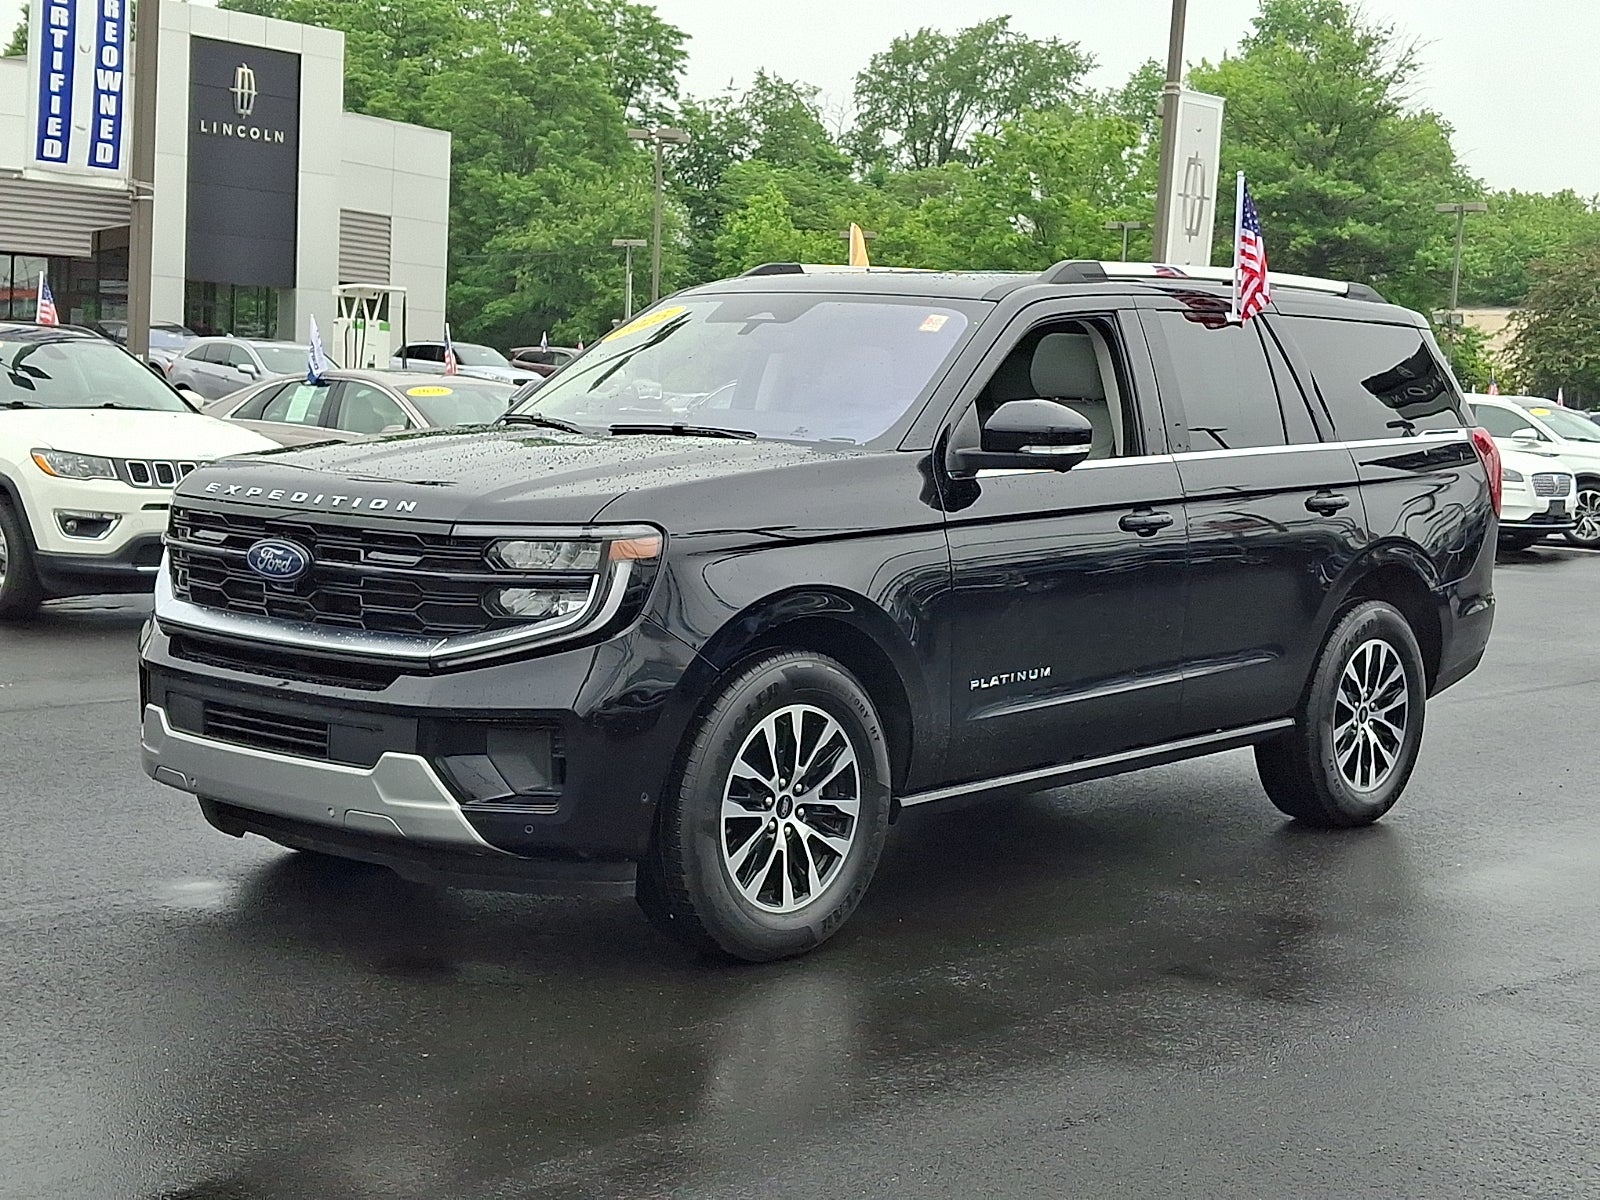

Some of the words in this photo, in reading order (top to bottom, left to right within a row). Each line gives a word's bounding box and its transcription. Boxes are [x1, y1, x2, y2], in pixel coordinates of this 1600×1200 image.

[43, 0, 69, 158] RTIFIED
[200, 119, 285, 143] LINCOLN
[205, 482, 418, 512] EXPEDITION
[256, 546, 293, 573] Ford
[970, 666, 1051, 691] PLATINUM
